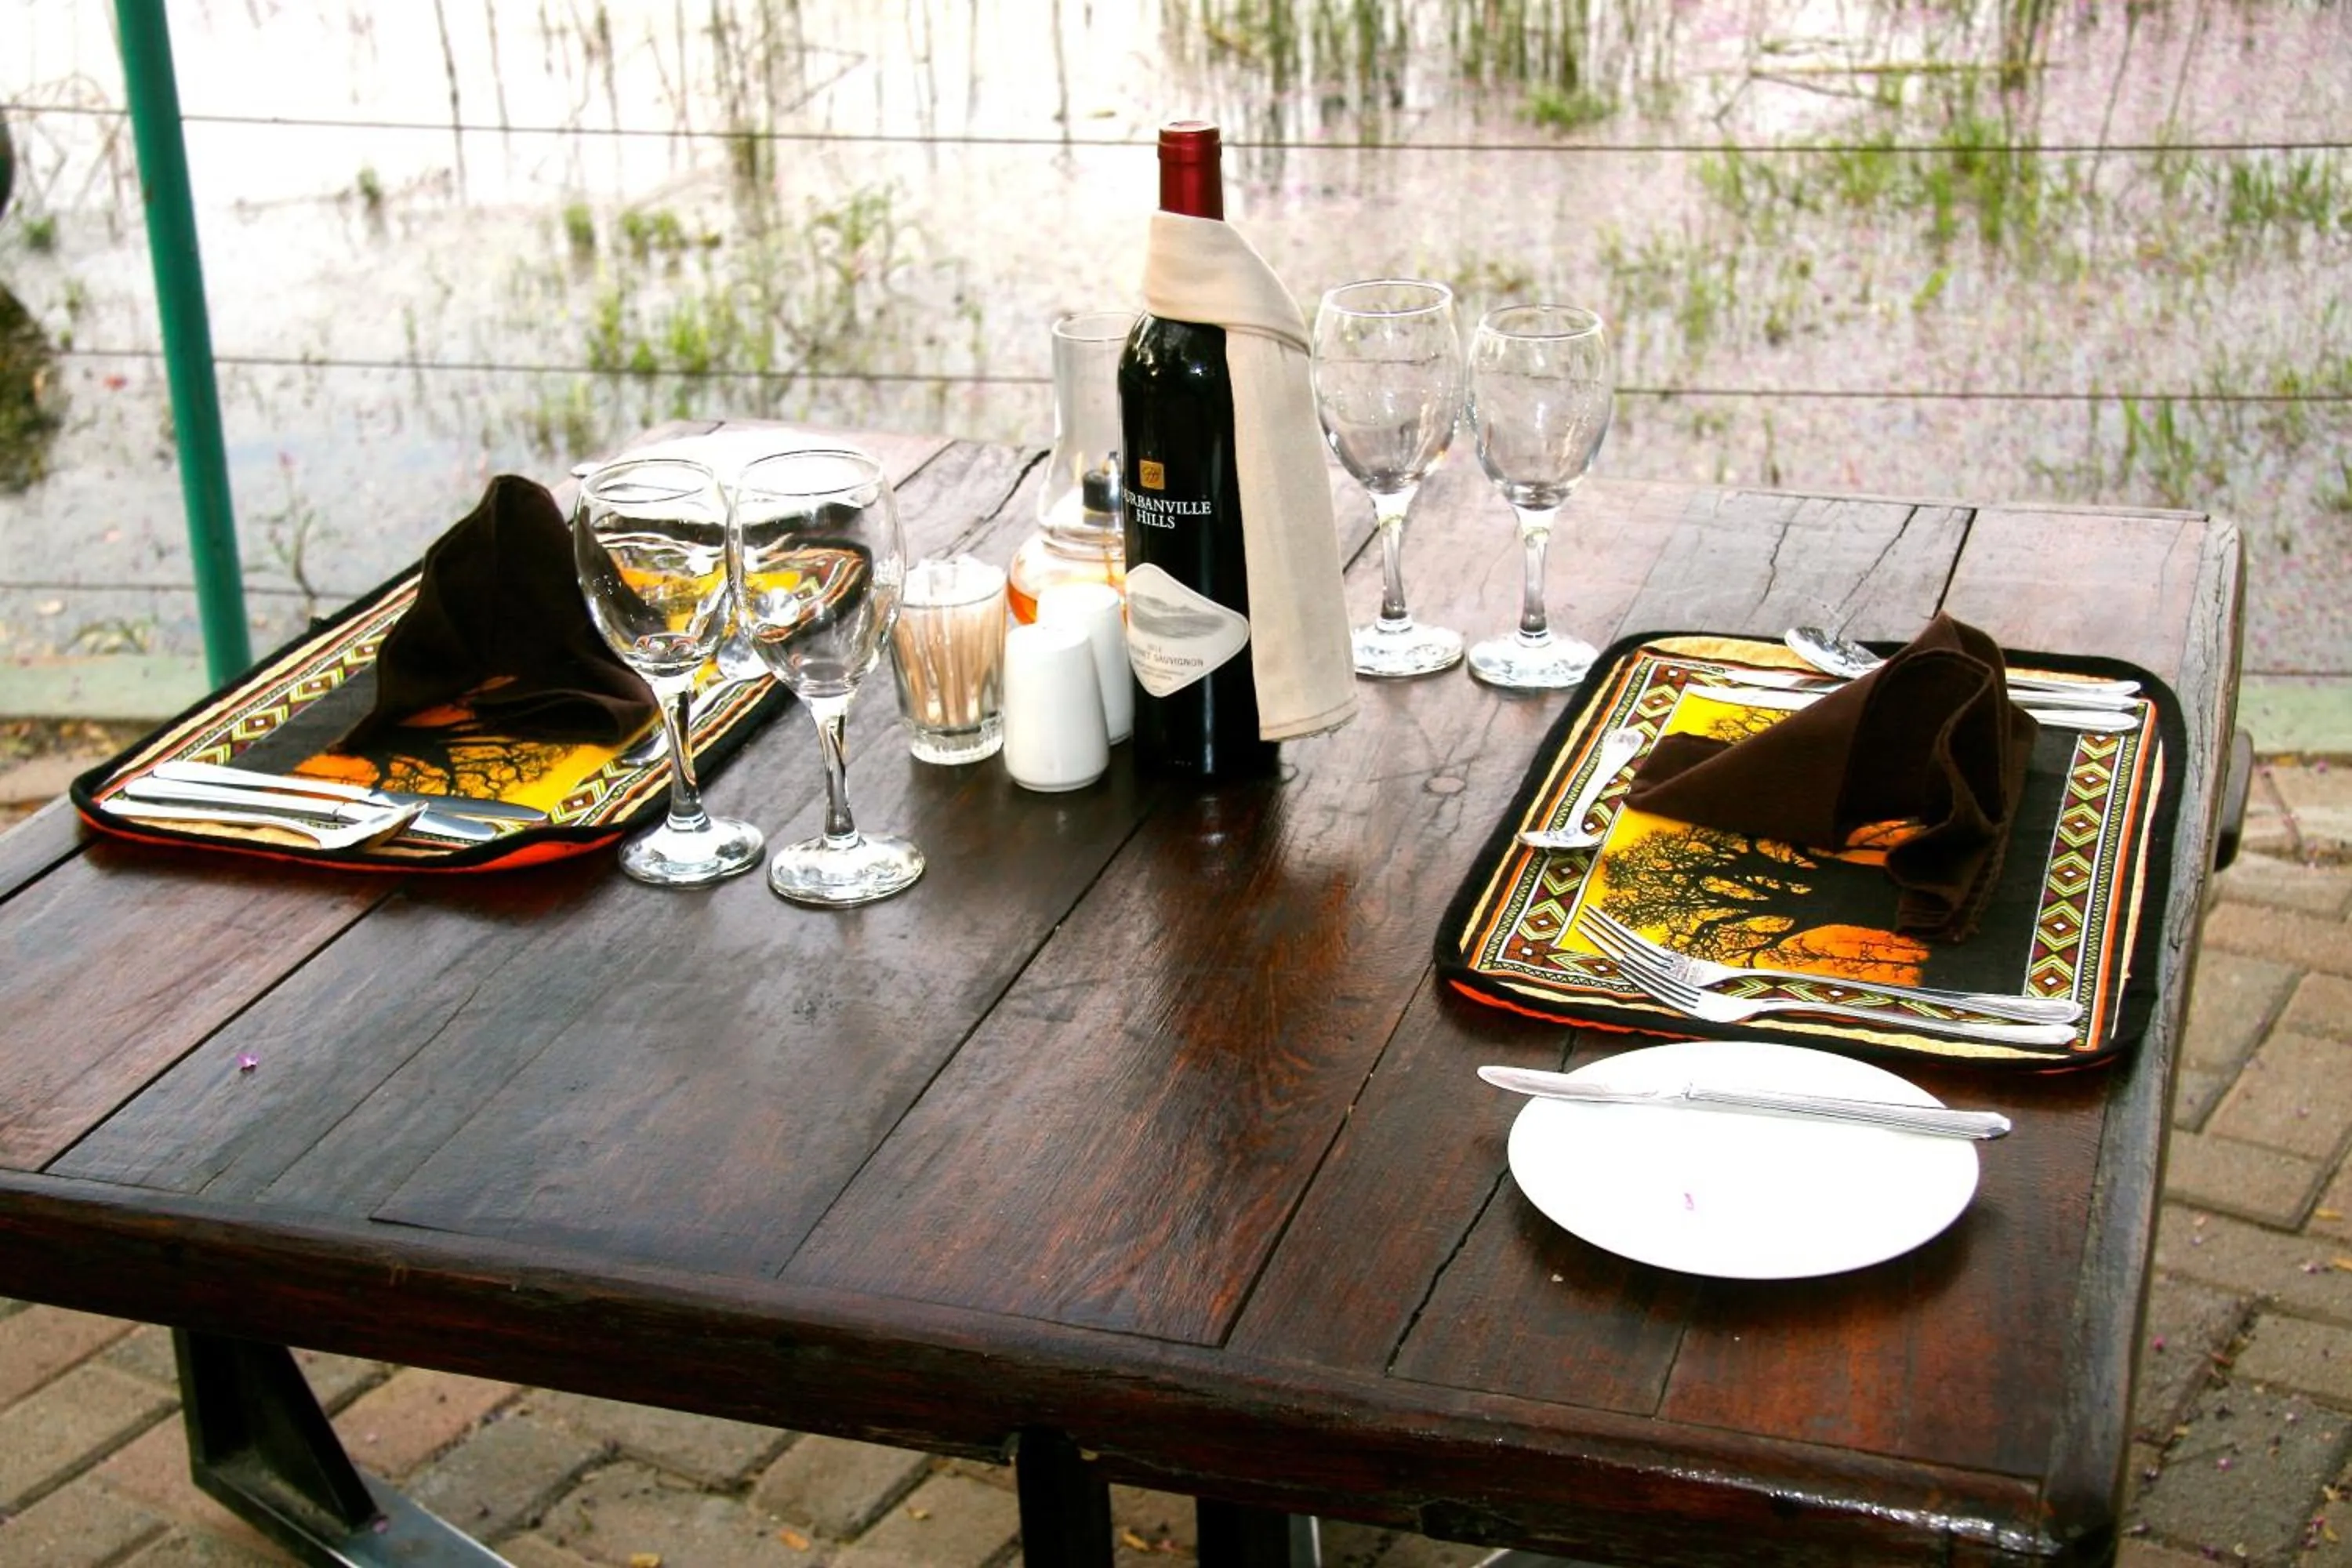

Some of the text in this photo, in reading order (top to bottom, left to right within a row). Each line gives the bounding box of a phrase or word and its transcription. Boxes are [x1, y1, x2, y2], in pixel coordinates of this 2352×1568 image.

[1123, 488, 1212, 515] URBANVILLE
[1136, 508, 1175, 529] HILLS
[1153, 653, 1204, 667] SAUVIGNON
